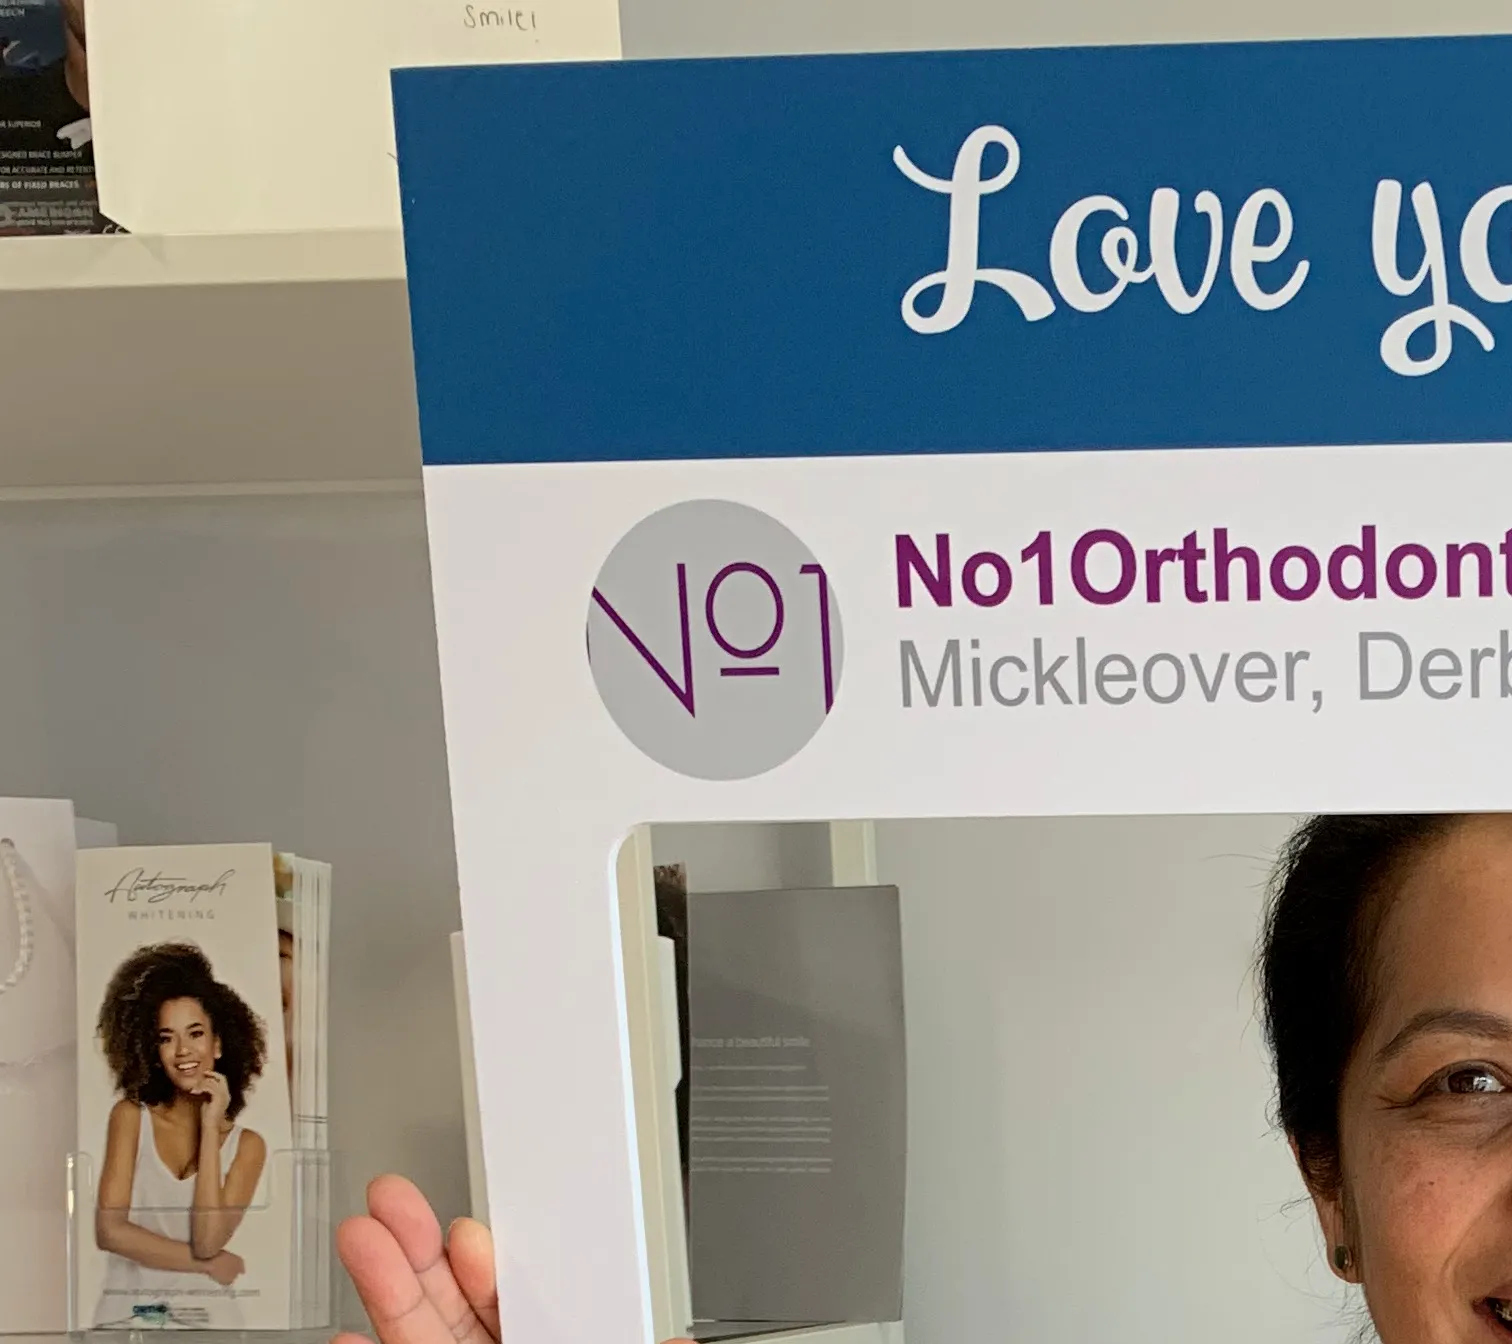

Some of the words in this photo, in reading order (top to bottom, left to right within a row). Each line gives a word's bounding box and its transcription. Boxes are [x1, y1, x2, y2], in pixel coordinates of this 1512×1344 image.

[893, 125, 1310, 334] Love
[898, 636, 1328, 713] Mickleover,
[104, 867, 236, 903] Autograph
[127, 909, 216, 921] WHITENING
